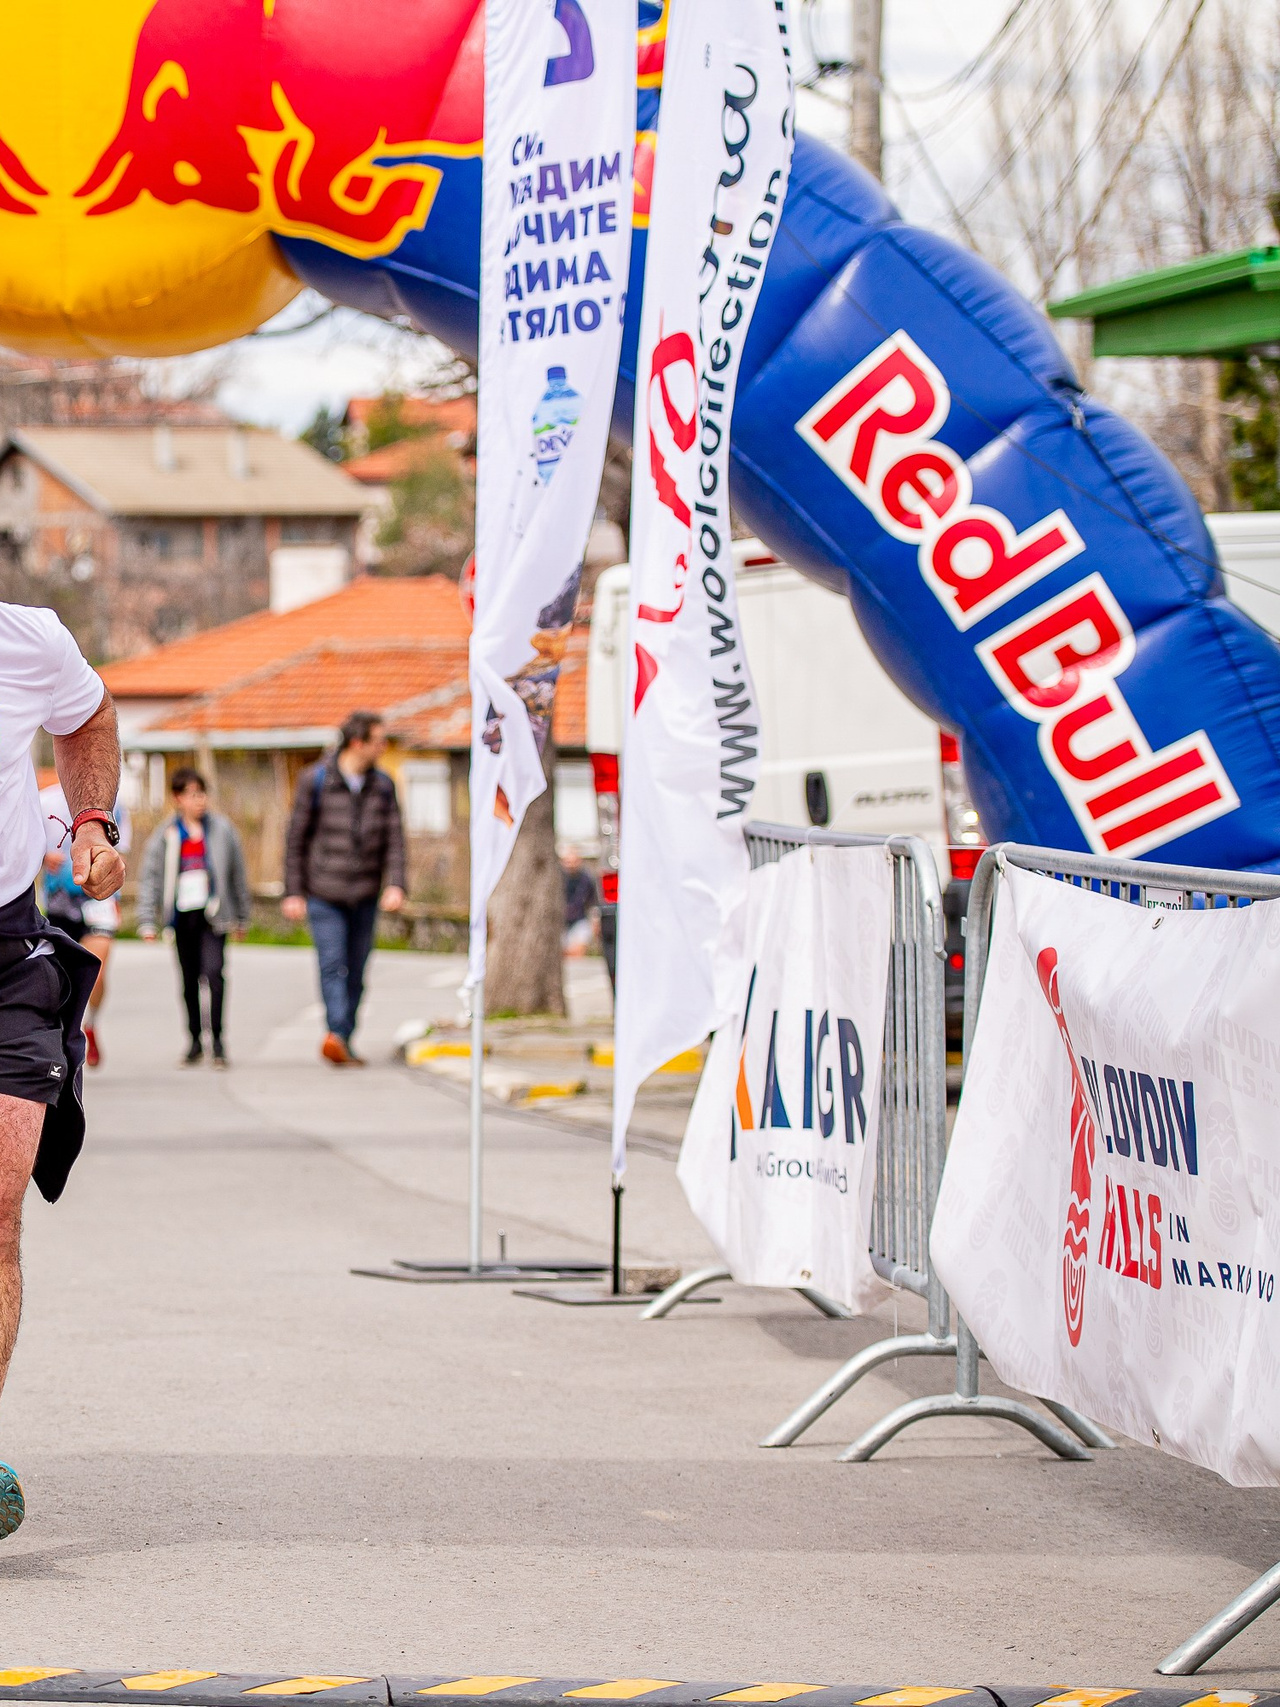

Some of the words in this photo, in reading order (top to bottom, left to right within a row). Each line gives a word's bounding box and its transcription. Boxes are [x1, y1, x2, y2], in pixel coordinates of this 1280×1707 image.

[804, 340, 1077, 621] Red
[983, 581, 1232, 857] Bull
[1169, 1212, 1190, 1244] IN
[1171, 1257, 1275, 1303] MARKOVO
